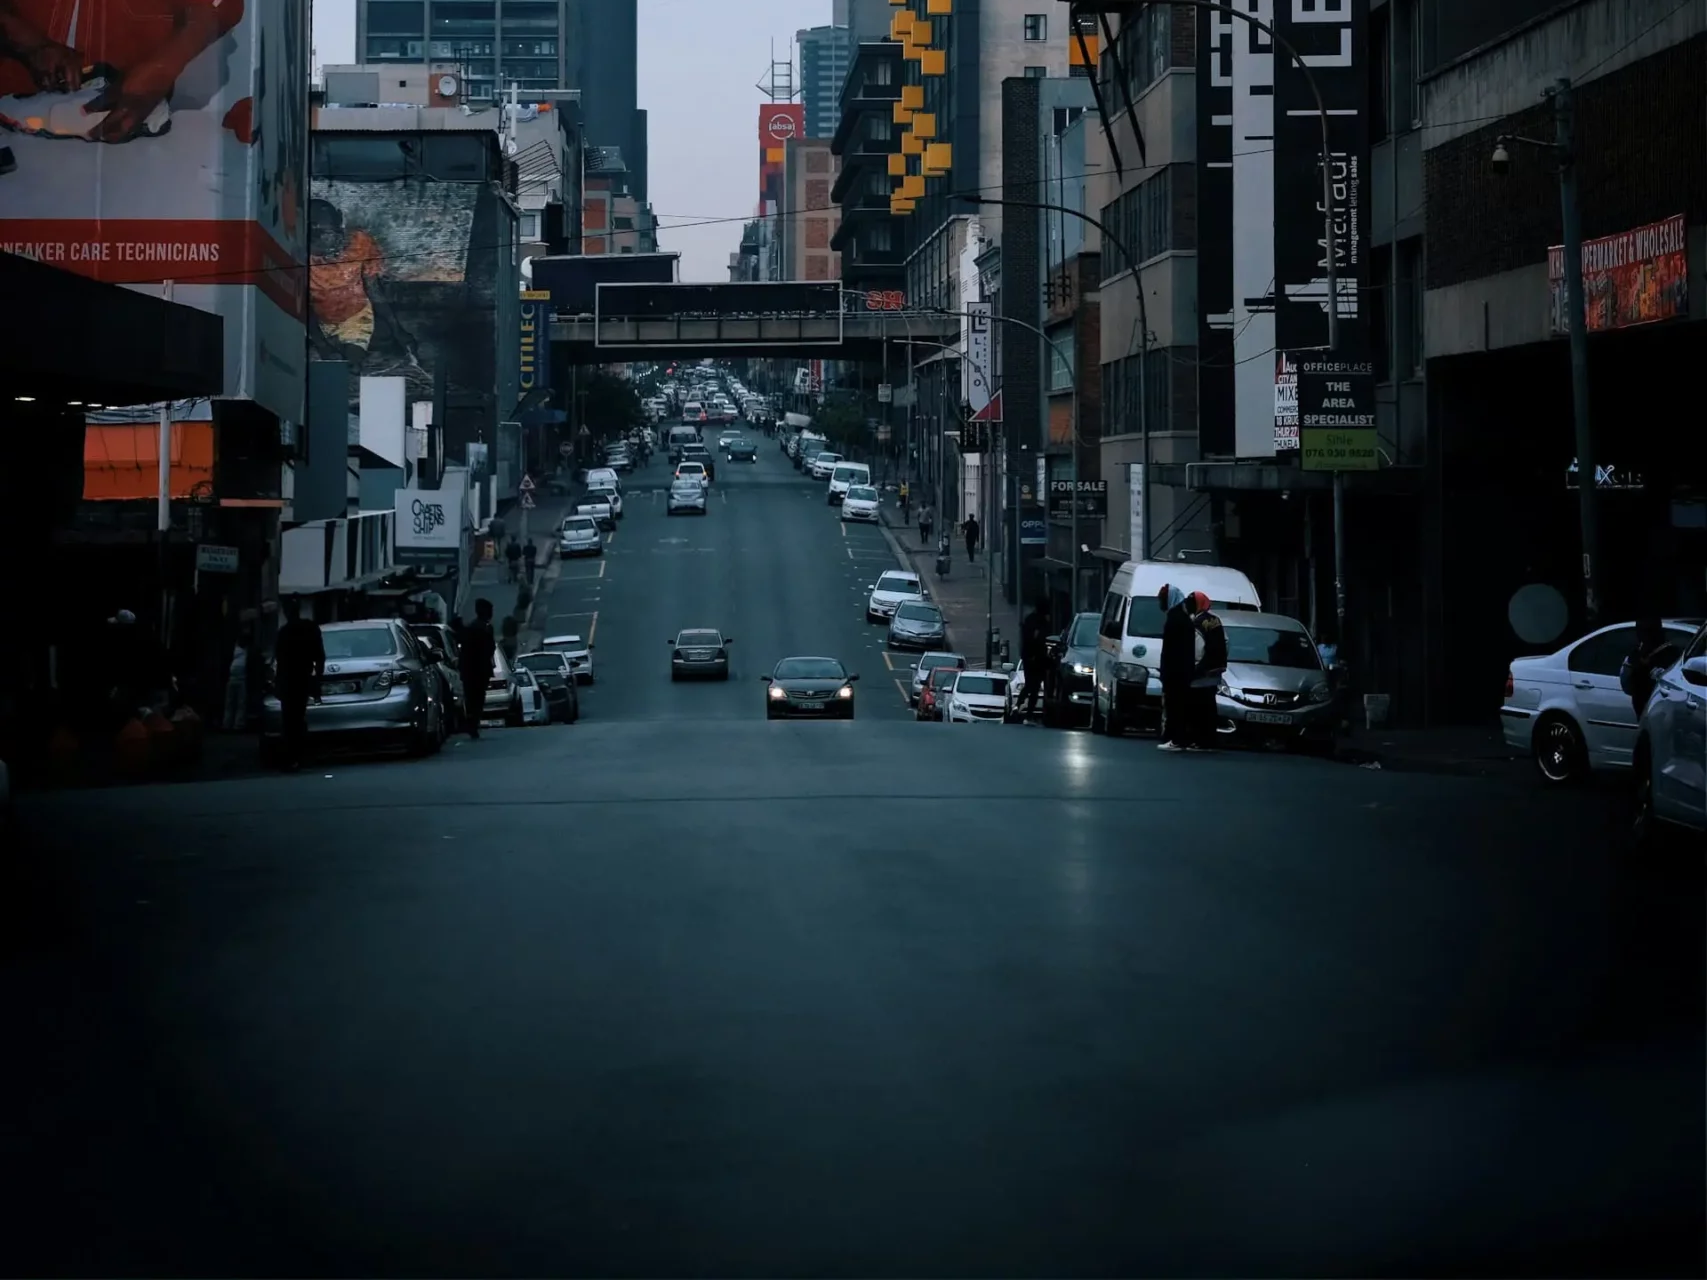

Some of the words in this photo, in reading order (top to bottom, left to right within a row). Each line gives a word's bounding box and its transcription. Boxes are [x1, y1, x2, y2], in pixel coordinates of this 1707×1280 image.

[771, 121, 793, 130] absa
[1348, 155, 1358, 178] sales
[1350, 208, 1360, 264] management
[1582, 236, 1628, 273] PERMARKET
[1636, 219, 1685, 261] WHOLESALE
[70, 243, 110, 261] CARE
[116, 243, 220, 262] TECHNICIANS
[520, 303, 536, 389] CITILEC
[1303, 362, 1373, 372] OFFICEPLACE
[1325, 382, 1352, 392] THE
[1321, 398, 1356, 409] AREA
[1303, 414, 1375, 425] SPECIALIST
[1051, 481, 1074, 491] FOR
[1077, 481, 1106, 492] SALE
